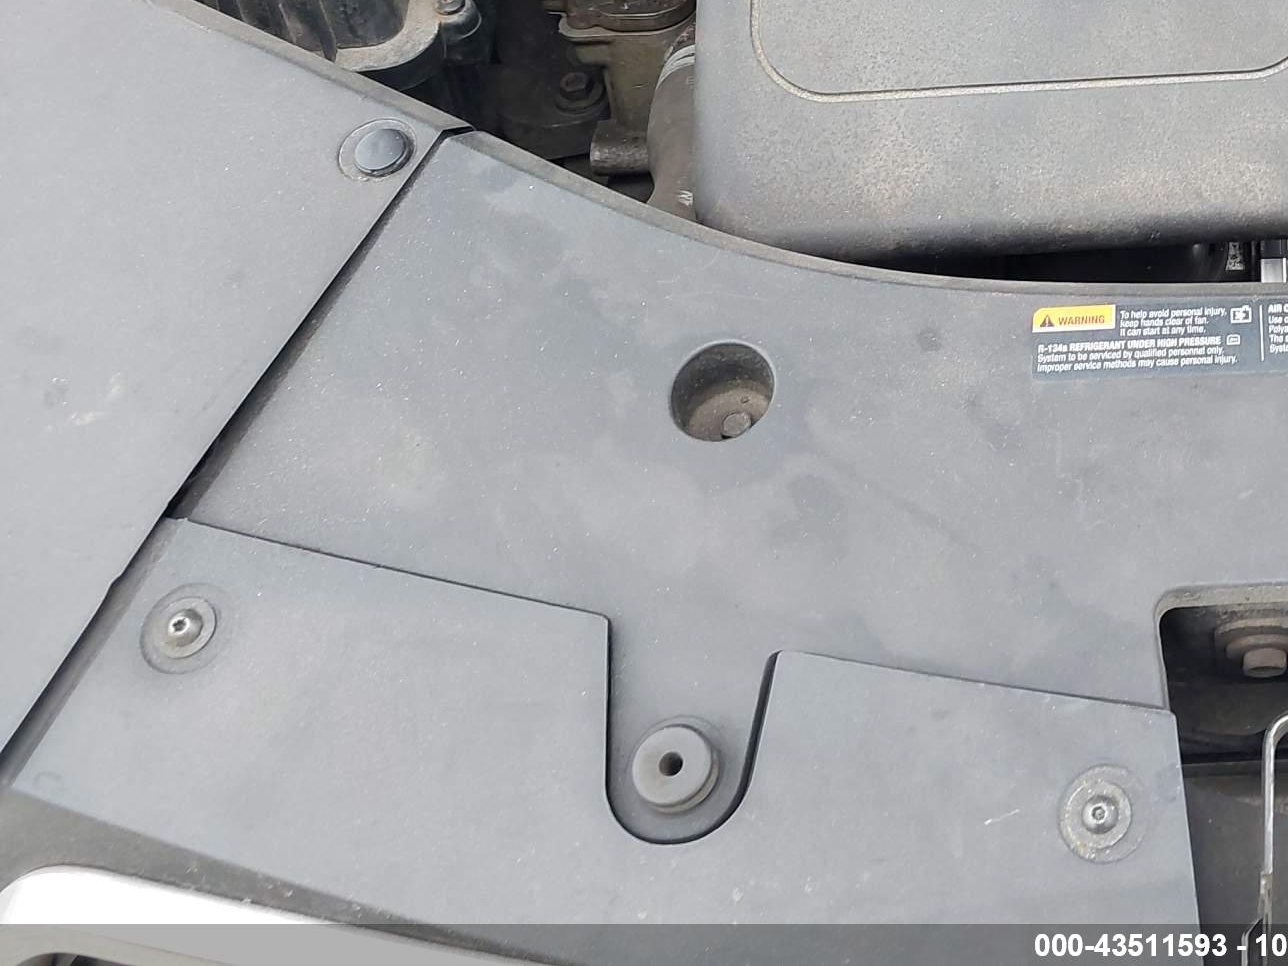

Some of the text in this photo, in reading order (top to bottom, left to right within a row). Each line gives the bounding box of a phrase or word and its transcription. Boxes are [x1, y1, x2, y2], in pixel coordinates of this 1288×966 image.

[1120, 310, 1129, 318] To
[1131, 310, 1147, 320] help
[1149, 309, 1169, 318] avoid
[1171, 308, 1202, 318] personal
[1268, 304, 1282, 313] AIR
[1058, 315, 1105, 325] WARNING
[1120, 320, 1138, 329] keep
[1141, 318, 1163, 326] hands
[1165, 318, 1183, 326] clear
[1195, 316, 1209, 324] fan.
[1268, 316, 1282, 324] Use
[1143, 327, 1160, 335] start
[1171, 327, 1185, 335] any
[1038, 336, 1221, 353] R-134a REFRIGERANT UNDER HIGH PRESSURE
[1270, 335, 1283, 343] The
[1038, 353, 1066, 364] System
[1068, 352, 1076, 361] to
[1078, 352, 1087, 361] be
[1089, 350, 1121, 360] serviced
[1123, 350, 1132, 359] by
[1134, 348, 1166, 358] qualified
[1168, 347, 1205, 357] personnel
[1037, 355, 1238, 373] Improper service methods may cause personal injury.
